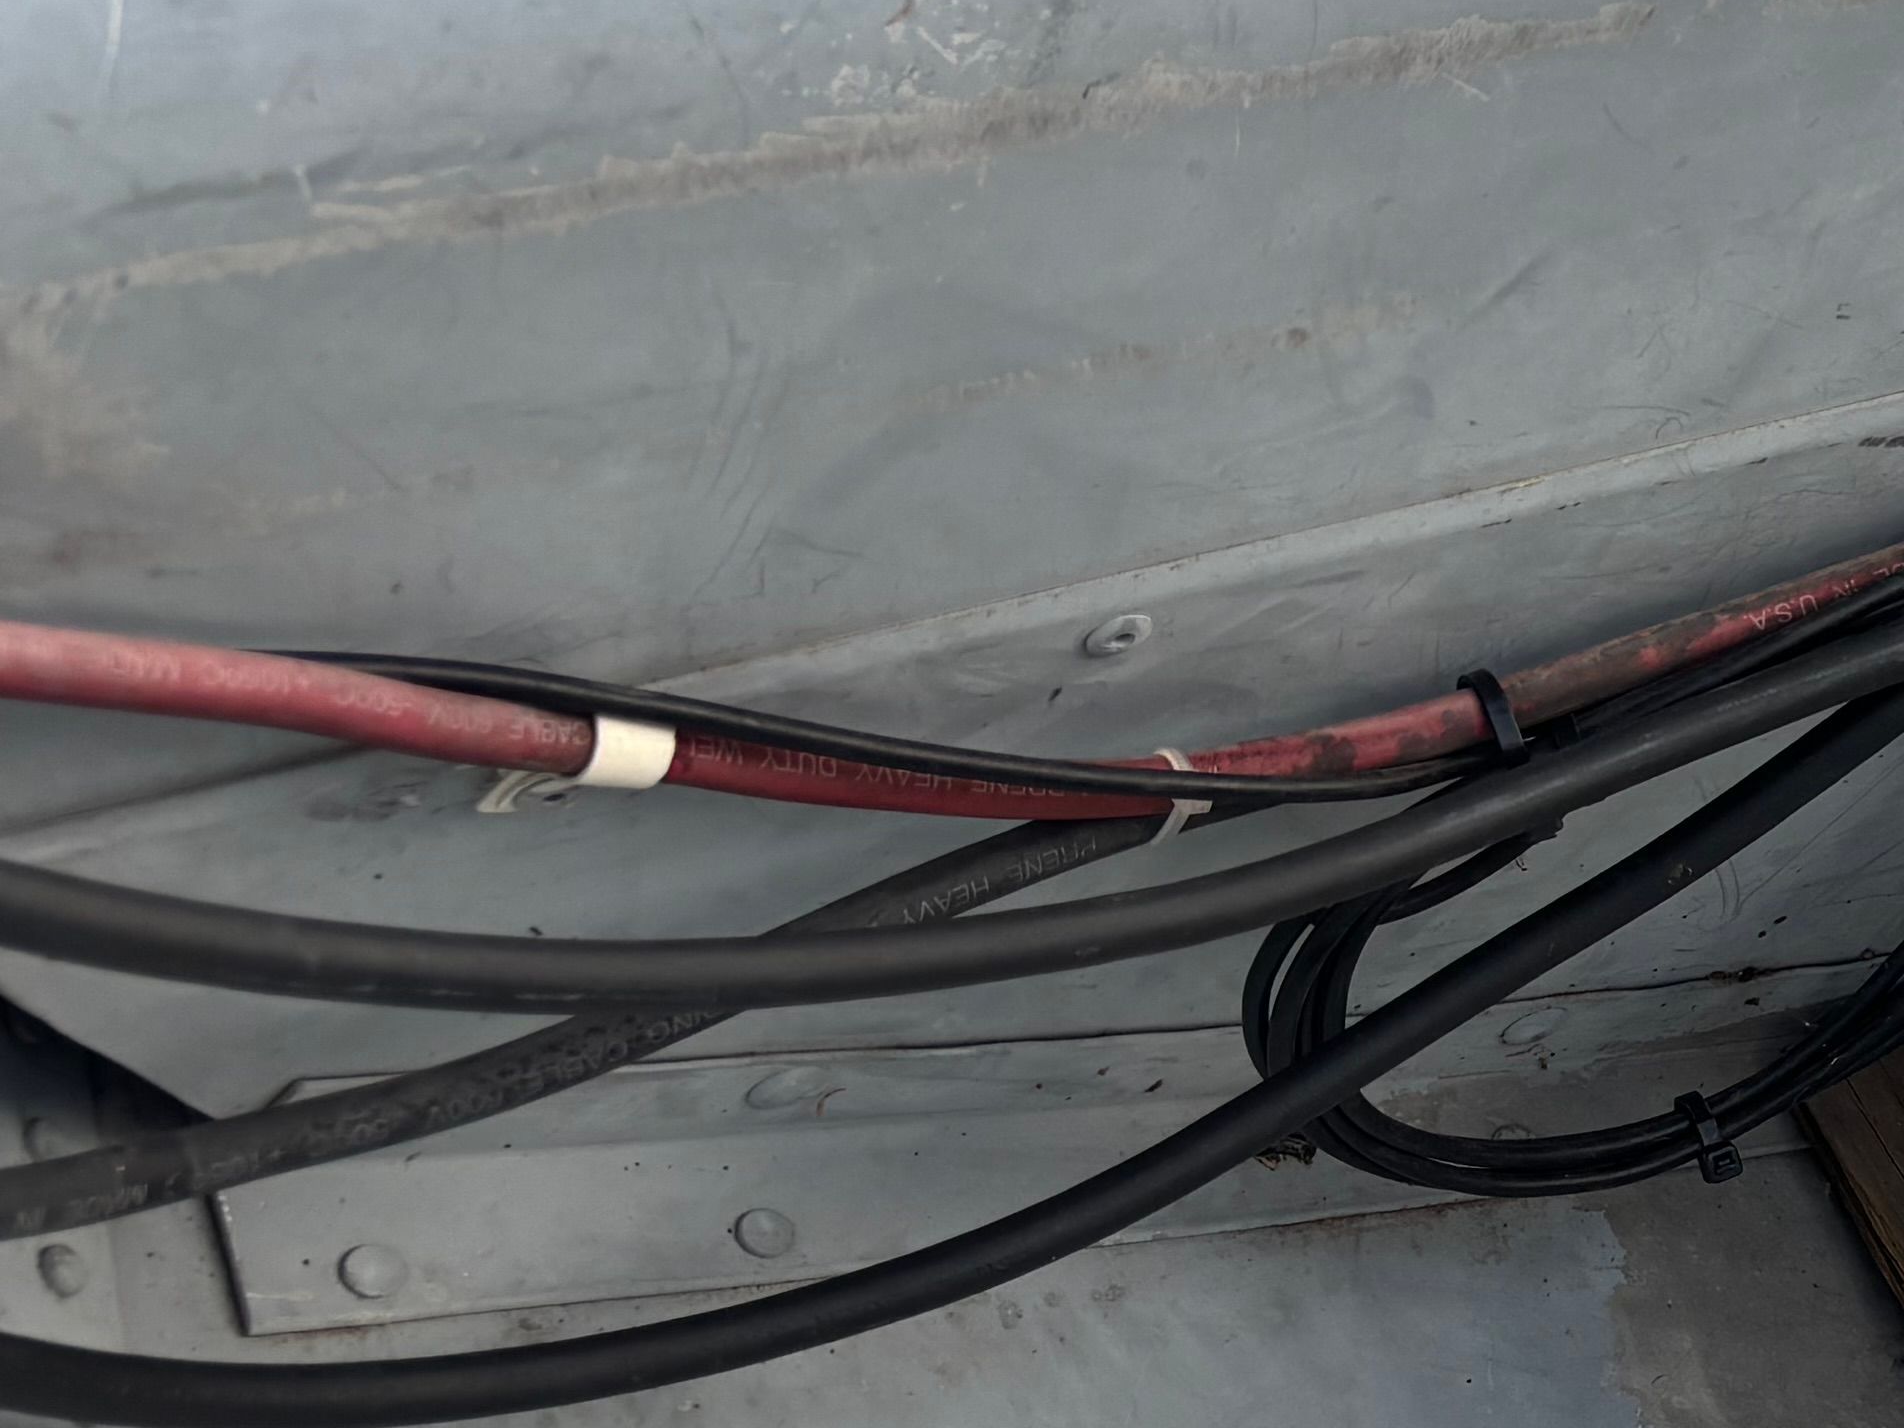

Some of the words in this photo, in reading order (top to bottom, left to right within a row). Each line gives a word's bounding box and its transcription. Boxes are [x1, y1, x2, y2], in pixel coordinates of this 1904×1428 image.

[1743, 593, 1819, 631] U.S.A.
[760, 745, 838, 779] DUTY
[902, 874, 991, 925] HEAVY
